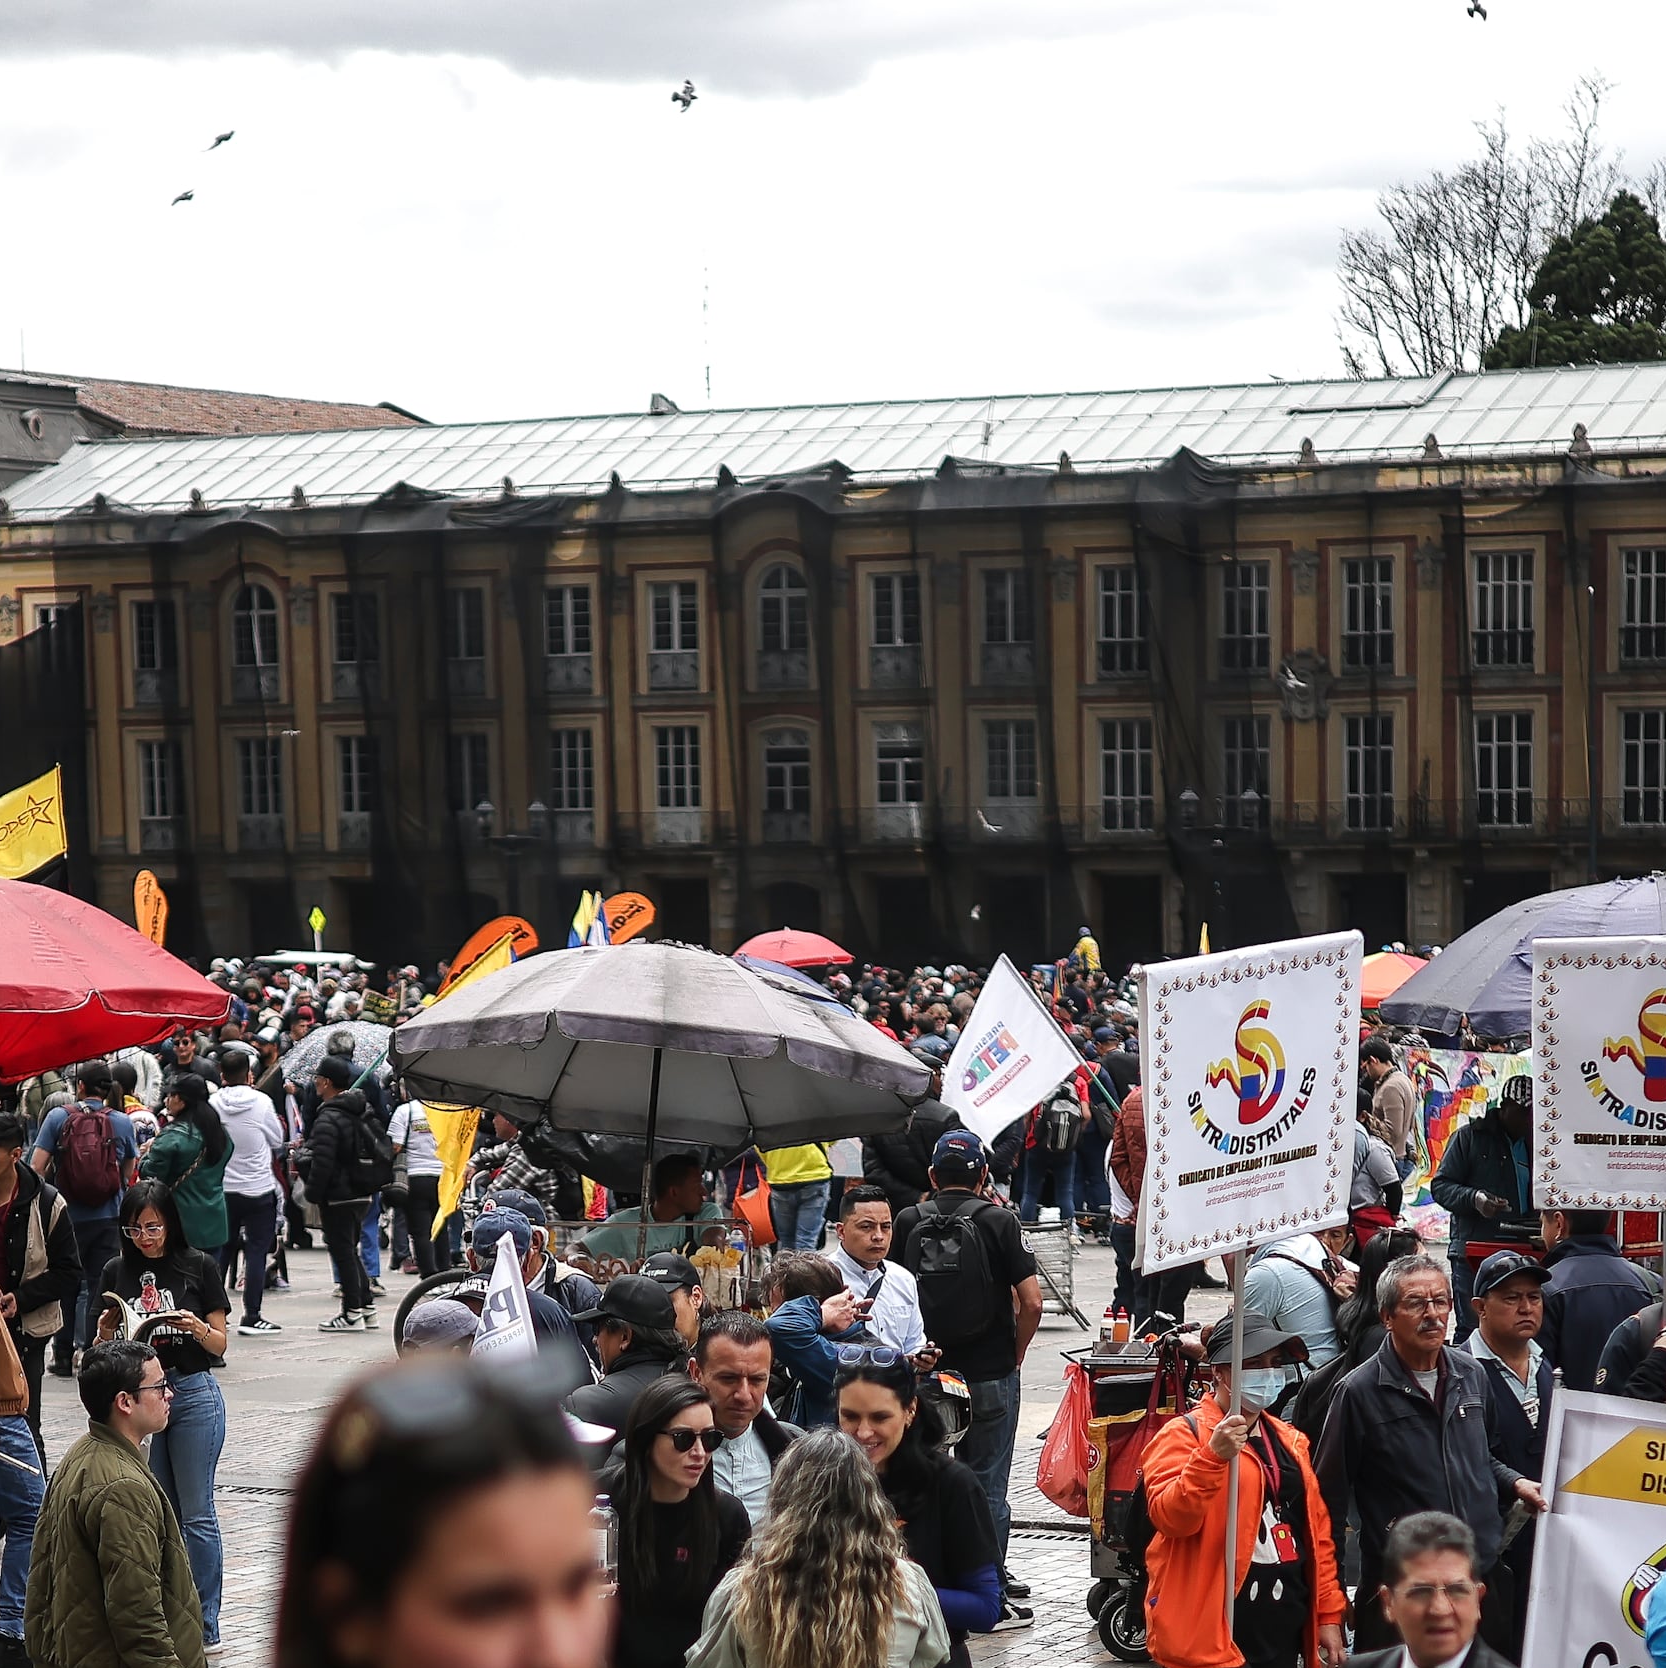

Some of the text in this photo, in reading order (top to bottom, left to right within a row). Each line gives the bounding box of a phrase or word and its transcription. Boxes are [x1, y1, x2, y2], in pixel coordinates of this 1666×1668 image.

[1187, 1067, 1317, 1155] SINTRADISTRITALES
[1573, 1133, 1617, 1145] SINDICATO
[1618, 1134, 1630, 1146] DE
[1178, 1167, 1216, 1187] SINDICATO
[1216, 1165, 1225, 1179] DE
[1225, 1157, 1263, 1176] EMPLEADOS
[1269, 1144, 1318, 1166] TRABAJADORES
[1205, 1182, 1285, 1207] sintradistritalesjd@gmail.com
